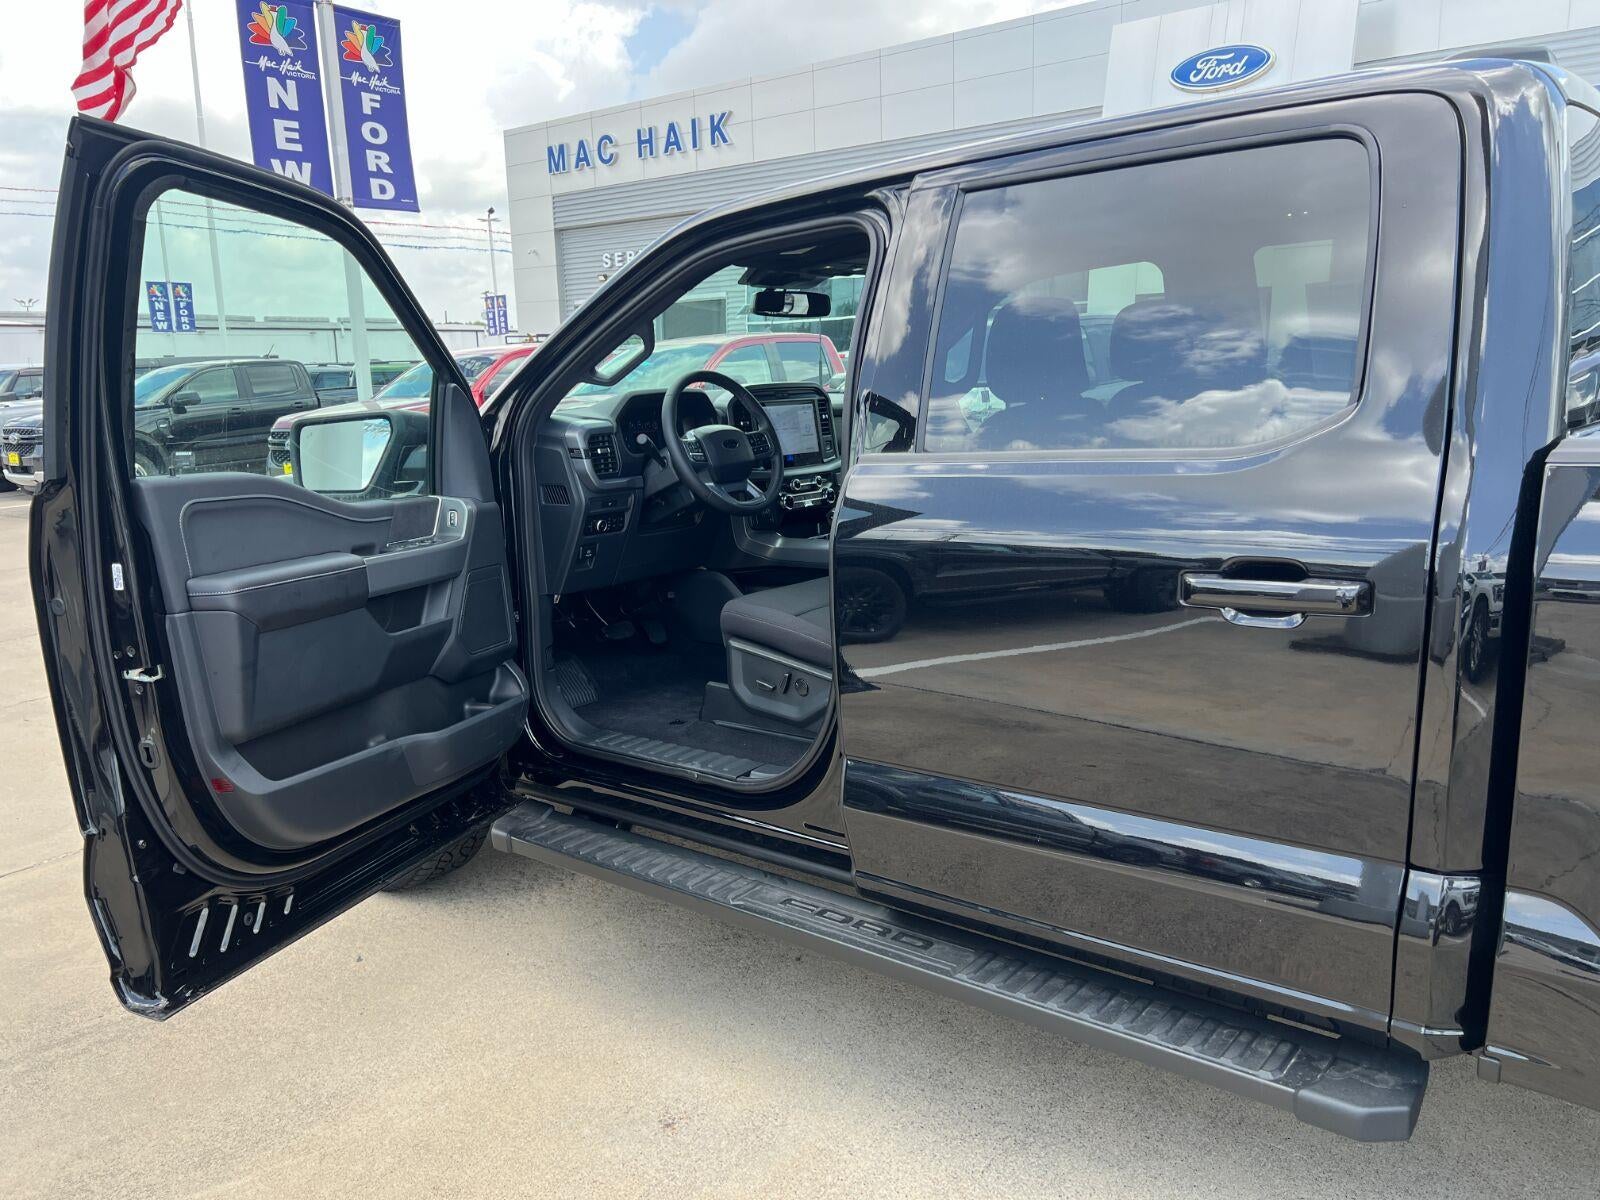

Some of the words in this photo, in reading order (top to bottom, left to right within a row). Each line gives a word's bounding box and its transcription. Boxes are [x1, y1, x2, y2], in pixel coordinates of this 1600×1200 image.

[249, 55, 279, 71] Mac
[279, 58, 315, 75] Haik
[286, 71, 317, 80] VICTORIA
[1189, 52, 1249, 83] Ford
[345, 70, 369, 87] Mac
[368, 74, 400, 90] Haik
[374, 87, 400, 95] VICTORIA
[266, 76, 312, 186] NEW
[547, 134, 617, 175] MAC
[636, 111, 733, 159] HAIK
[360, 91, 395, 201] FORD
[154, 301, 168, 330] NEW
[179, 301, 190, 330] FORD
[778, 898, 934, 950] FORD
